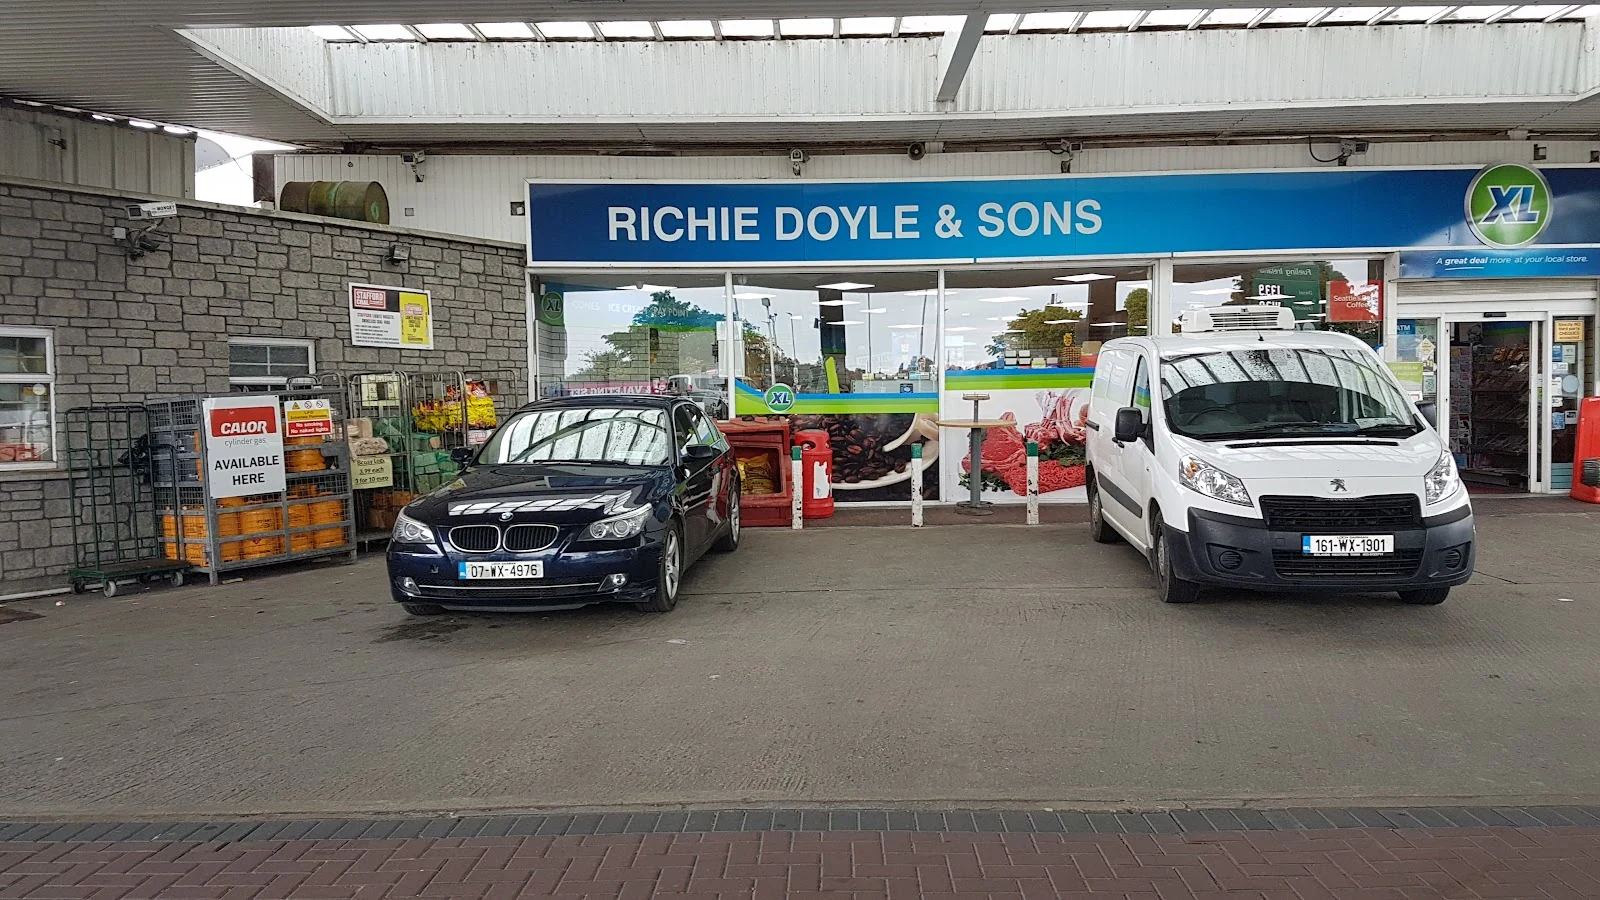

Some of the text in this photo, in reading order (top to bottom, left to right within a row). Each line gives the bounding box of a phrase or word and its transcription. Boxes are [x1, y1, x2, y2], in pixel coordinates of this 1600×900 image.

[1478, 185, 1540, 224] XL
[608, 198, 1103, 242] RICHIE DOYLE & SONS
[1436, 257, 1443, 265] A
[1445, 257, 1467, 266] great
[1470, 256, 1488, 264] deal
[356, 291, 384, 300] STAFFORD
[545, 298, 562, 313] XL
[608, 303, 620, 312] ICE
[668, 307, 690, 318] POINT
[770, 392, 790, 404] XL
[220, 420, 268, 434] CALOR
[224, 438, 252, 448] cylinder
[214, 455, 280, 470] AVAILABLE
[232, 472, 266, 486] HERE
[1316, 539, 1386, 552] 161-WX-1901
[471, 564, 538, 578] 07-WX-4976
